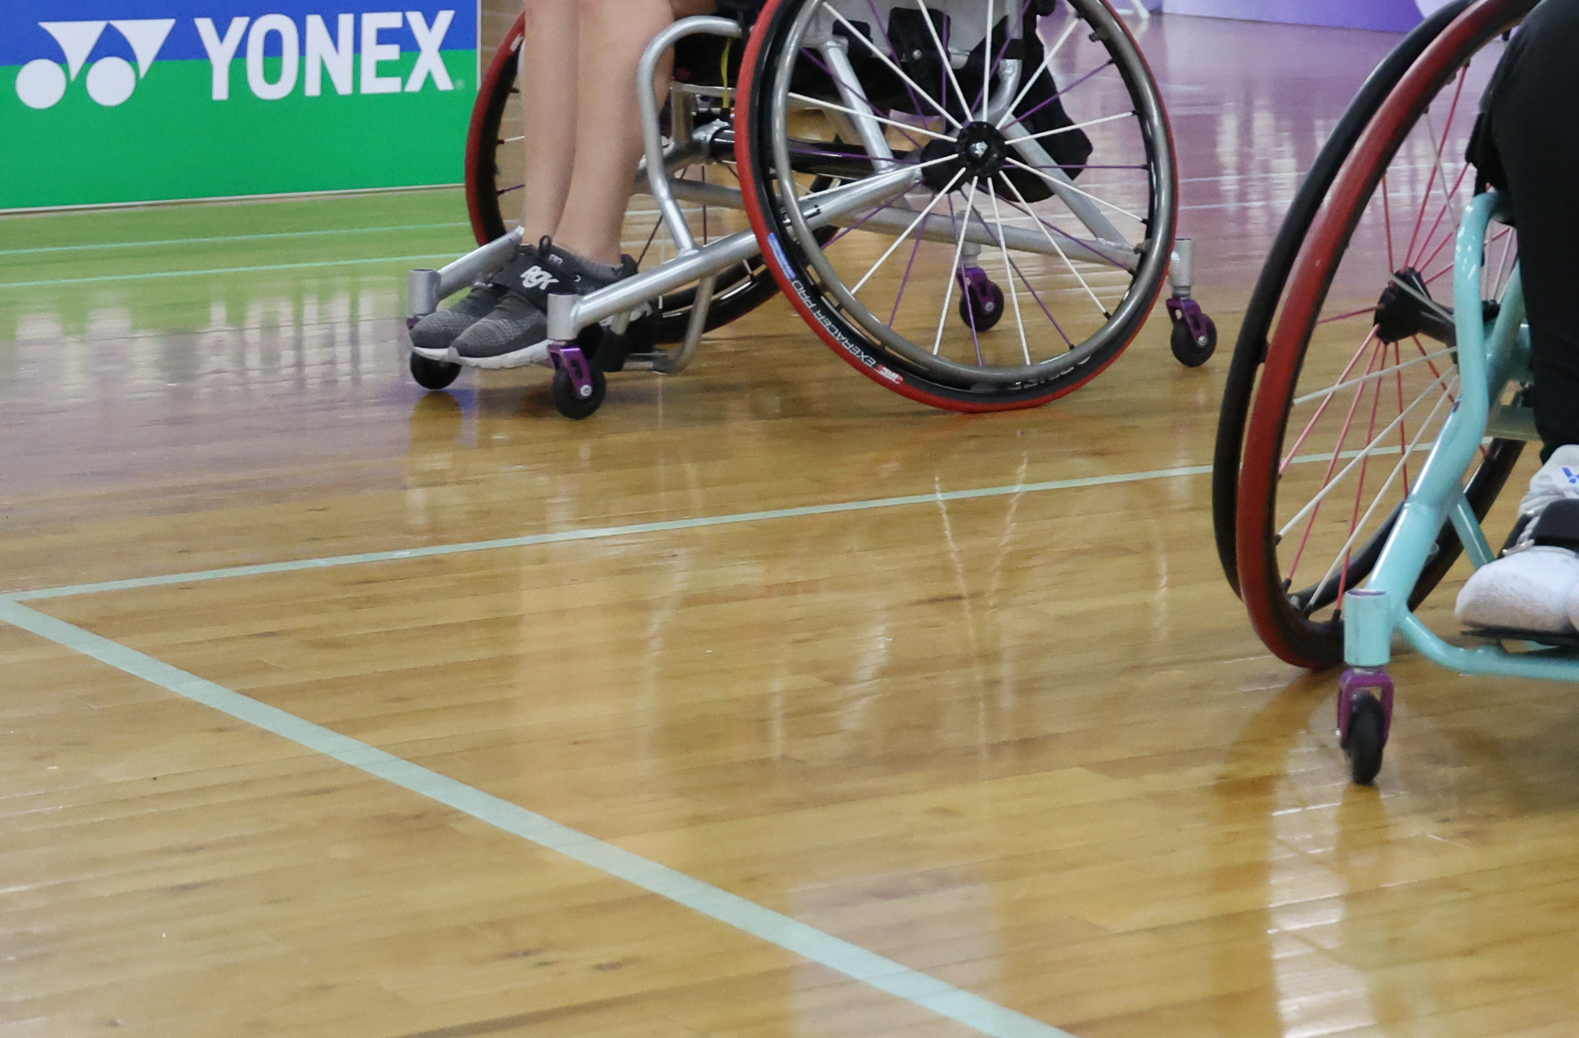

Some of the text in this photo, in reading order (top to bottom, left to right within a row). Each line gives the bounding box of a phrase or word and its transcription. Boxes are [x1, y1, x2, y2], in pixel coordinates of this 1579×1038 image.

[194, 10, 455, 101] YONEX
[791, 280, 877, 368] EXERACER PRO
